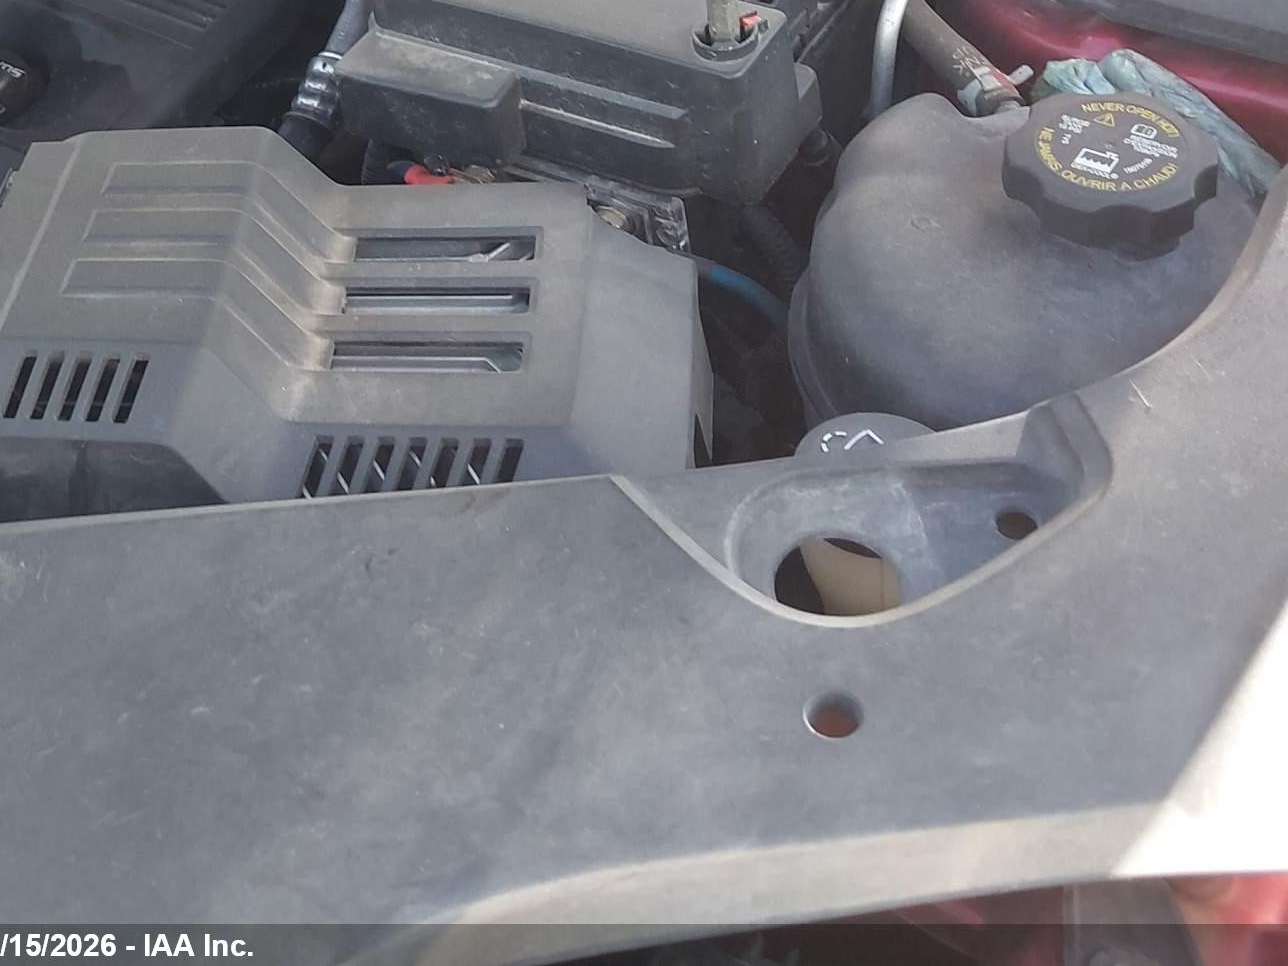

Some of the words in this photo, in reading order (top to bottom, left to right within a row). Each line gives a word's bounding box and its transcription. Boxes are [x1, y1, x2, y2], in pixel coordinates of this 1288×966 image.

[1081, 102, 1125, 113] NEVER
[1126, 105, 1159, 121] OPEN
[1062, 169, 1117, 192] OUVRIR
